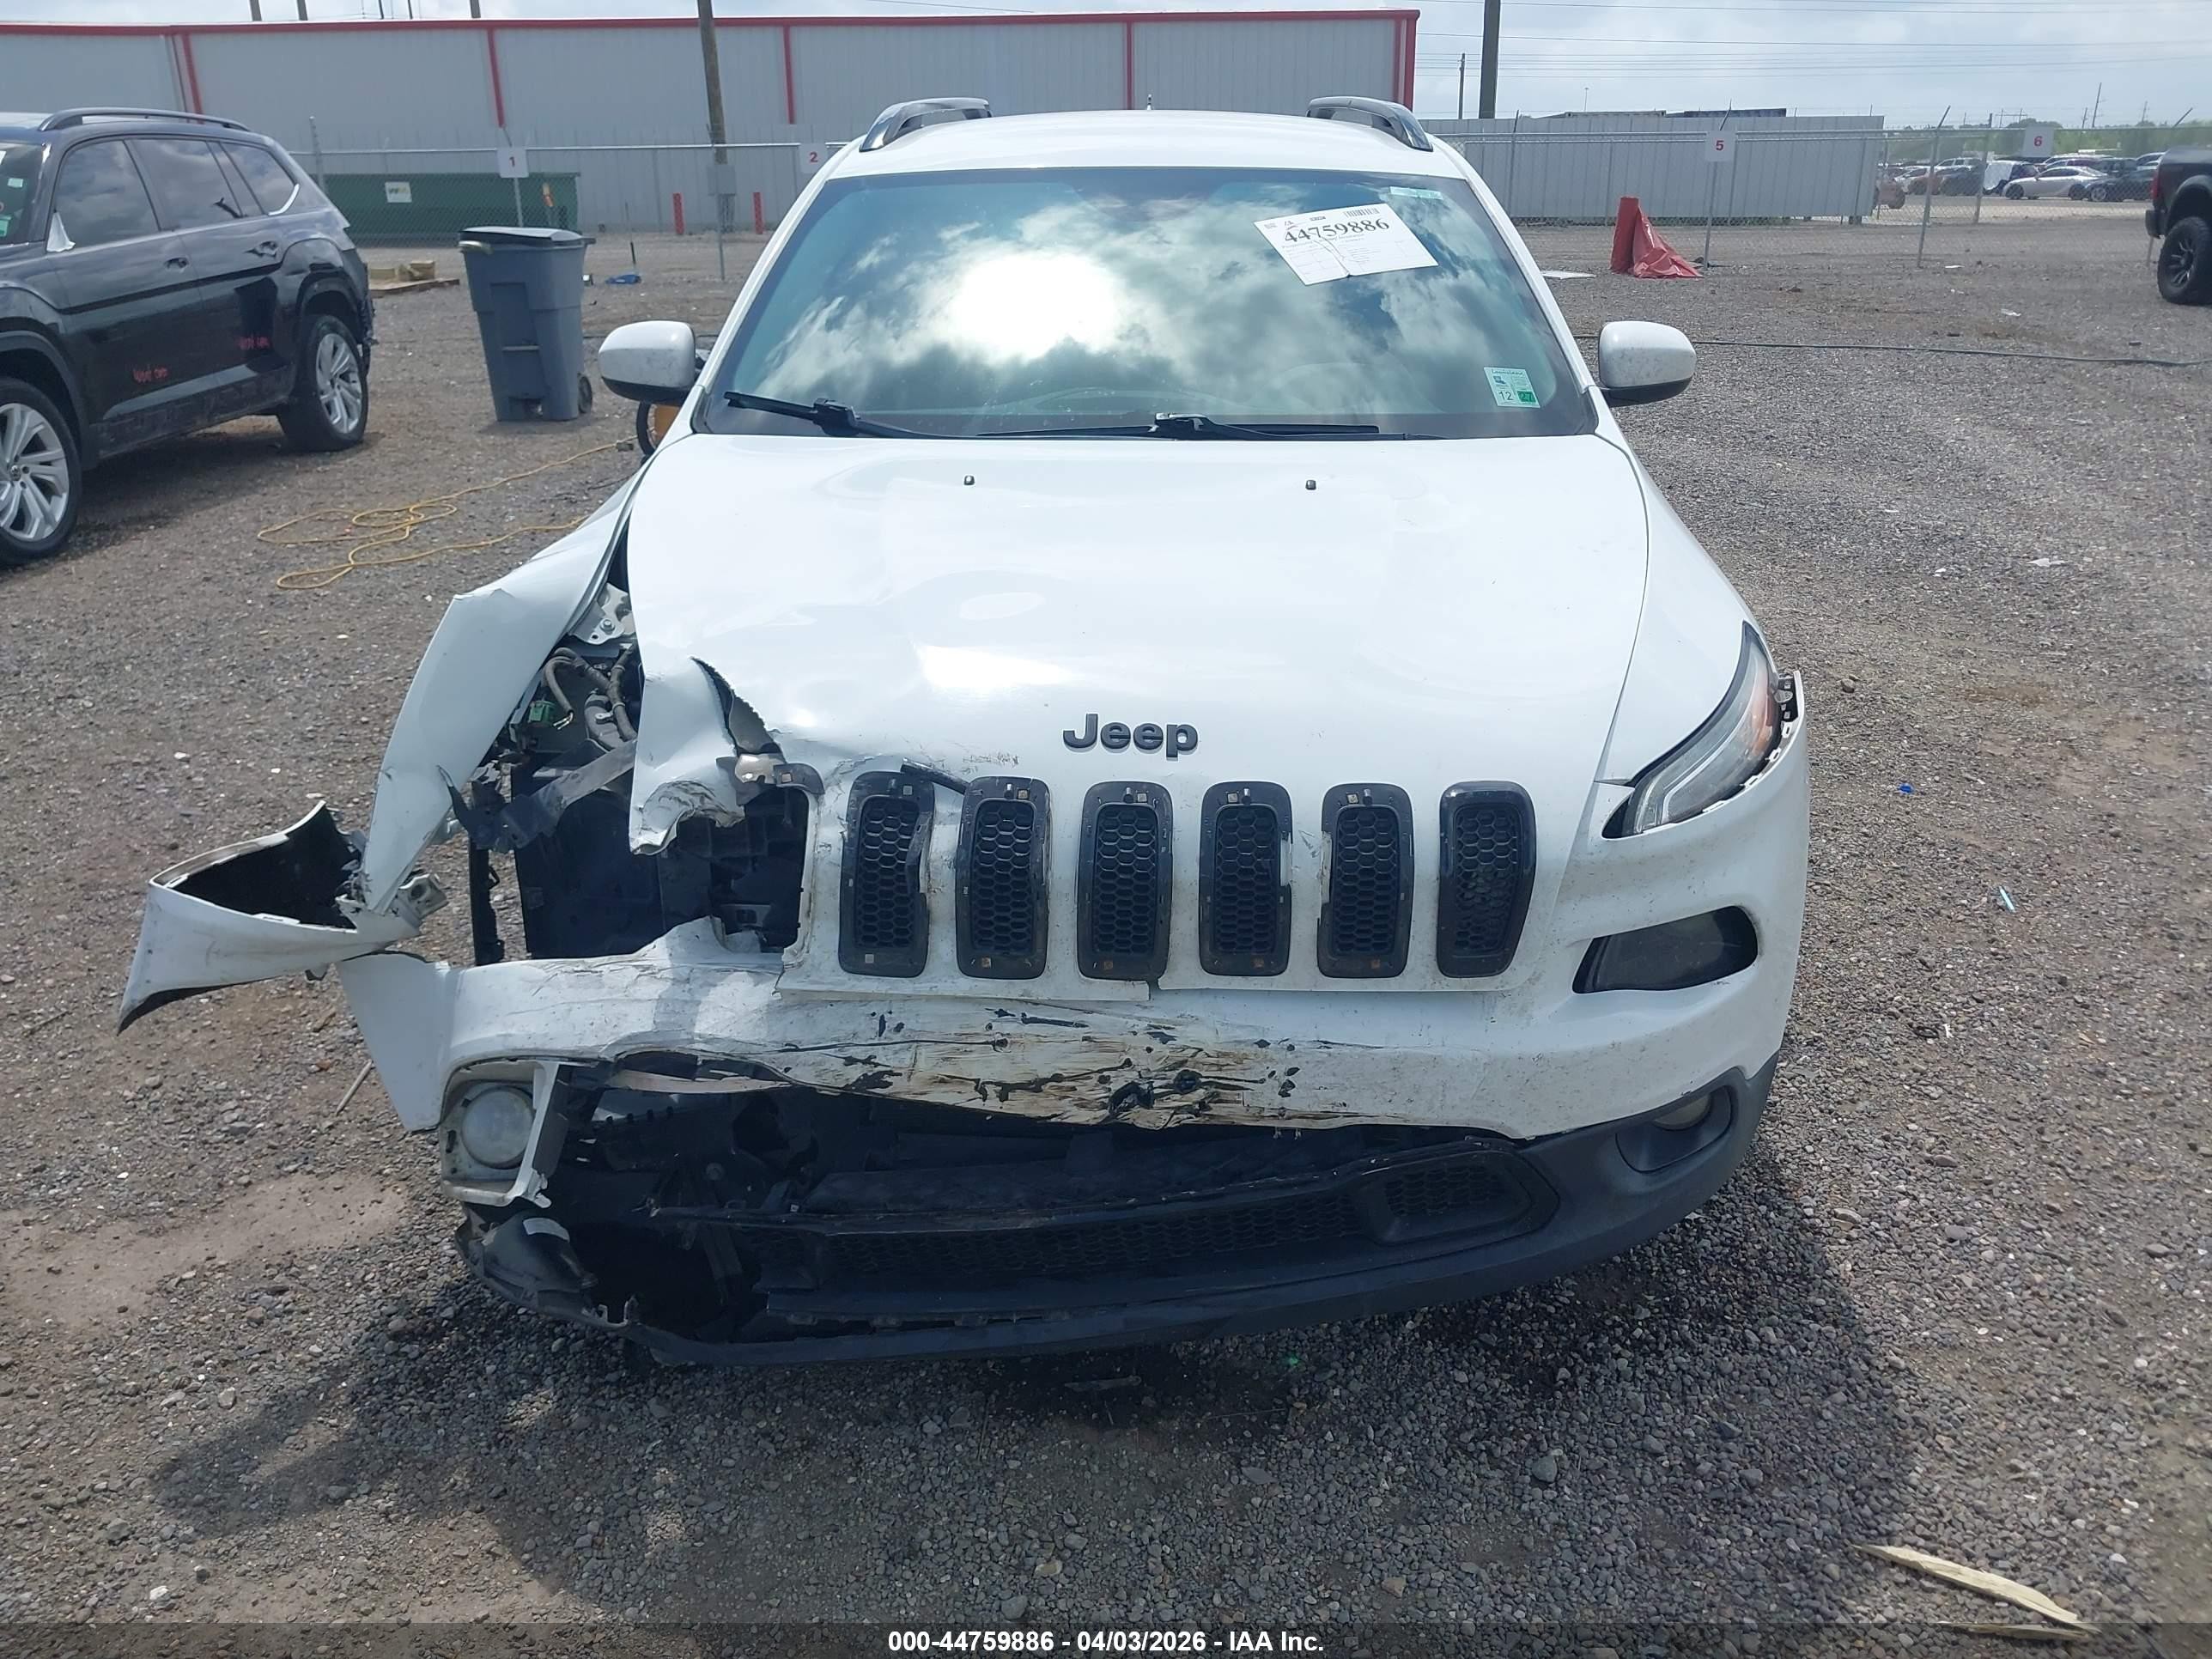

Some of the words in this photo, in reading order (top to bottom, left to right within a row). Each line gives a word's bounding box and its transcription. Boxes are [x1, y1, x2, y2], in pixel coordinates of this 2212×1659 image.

[1715, 139, 1724, 151] 5
[2033, 135, 2043, 147] 6
[508, 155, 516, 167] 1
[809, 151, 818, 163] 2
[1284, 217, 1390, 243] 44759886
[1498, 391, 1514, 401] 12
[1062, 713, 1199, 760] Jeep
